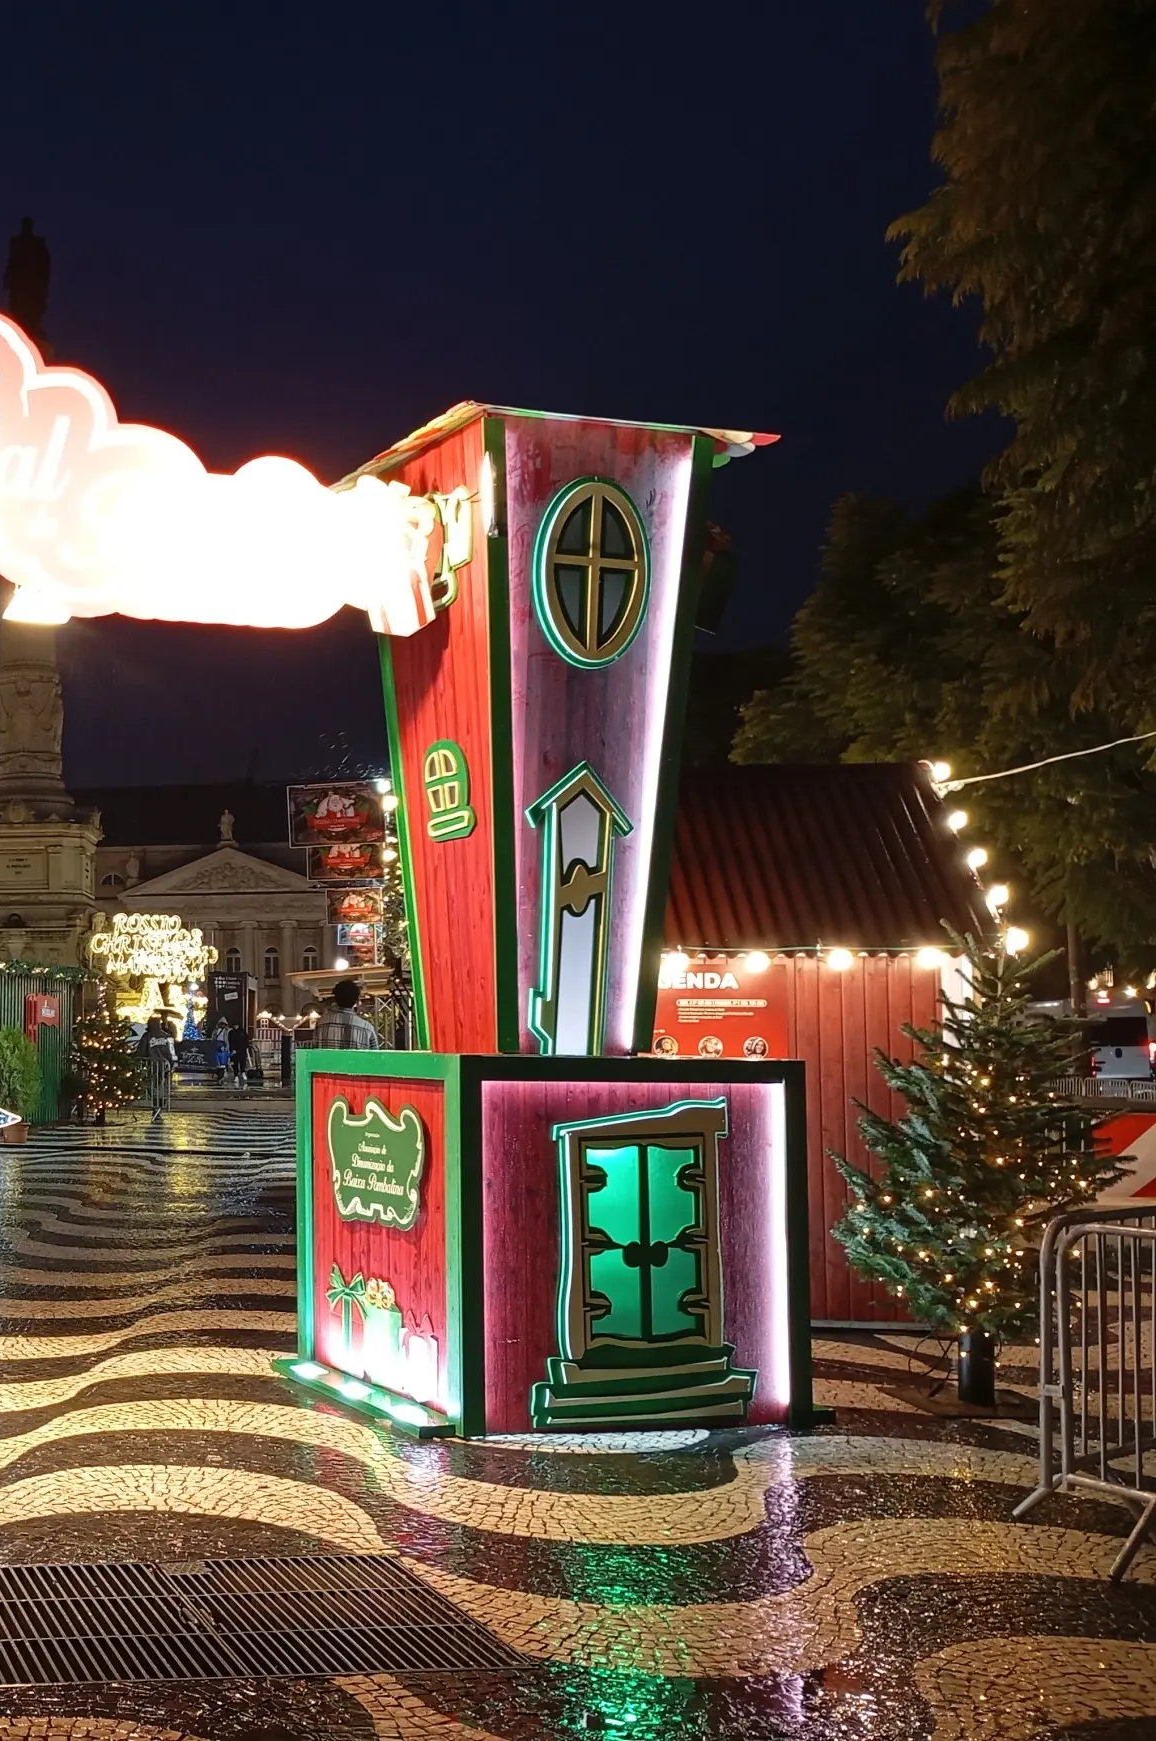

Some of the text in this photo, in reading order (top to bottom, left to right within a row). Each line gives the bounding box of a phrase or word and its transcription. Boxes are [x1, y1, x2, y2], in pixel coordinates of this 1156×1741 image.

[113, 913, 182, 935] ROSSIO
[90, 930, 199, 957] CHRIS
[343, 1169, 404, 1196] Baixa Pombalina
